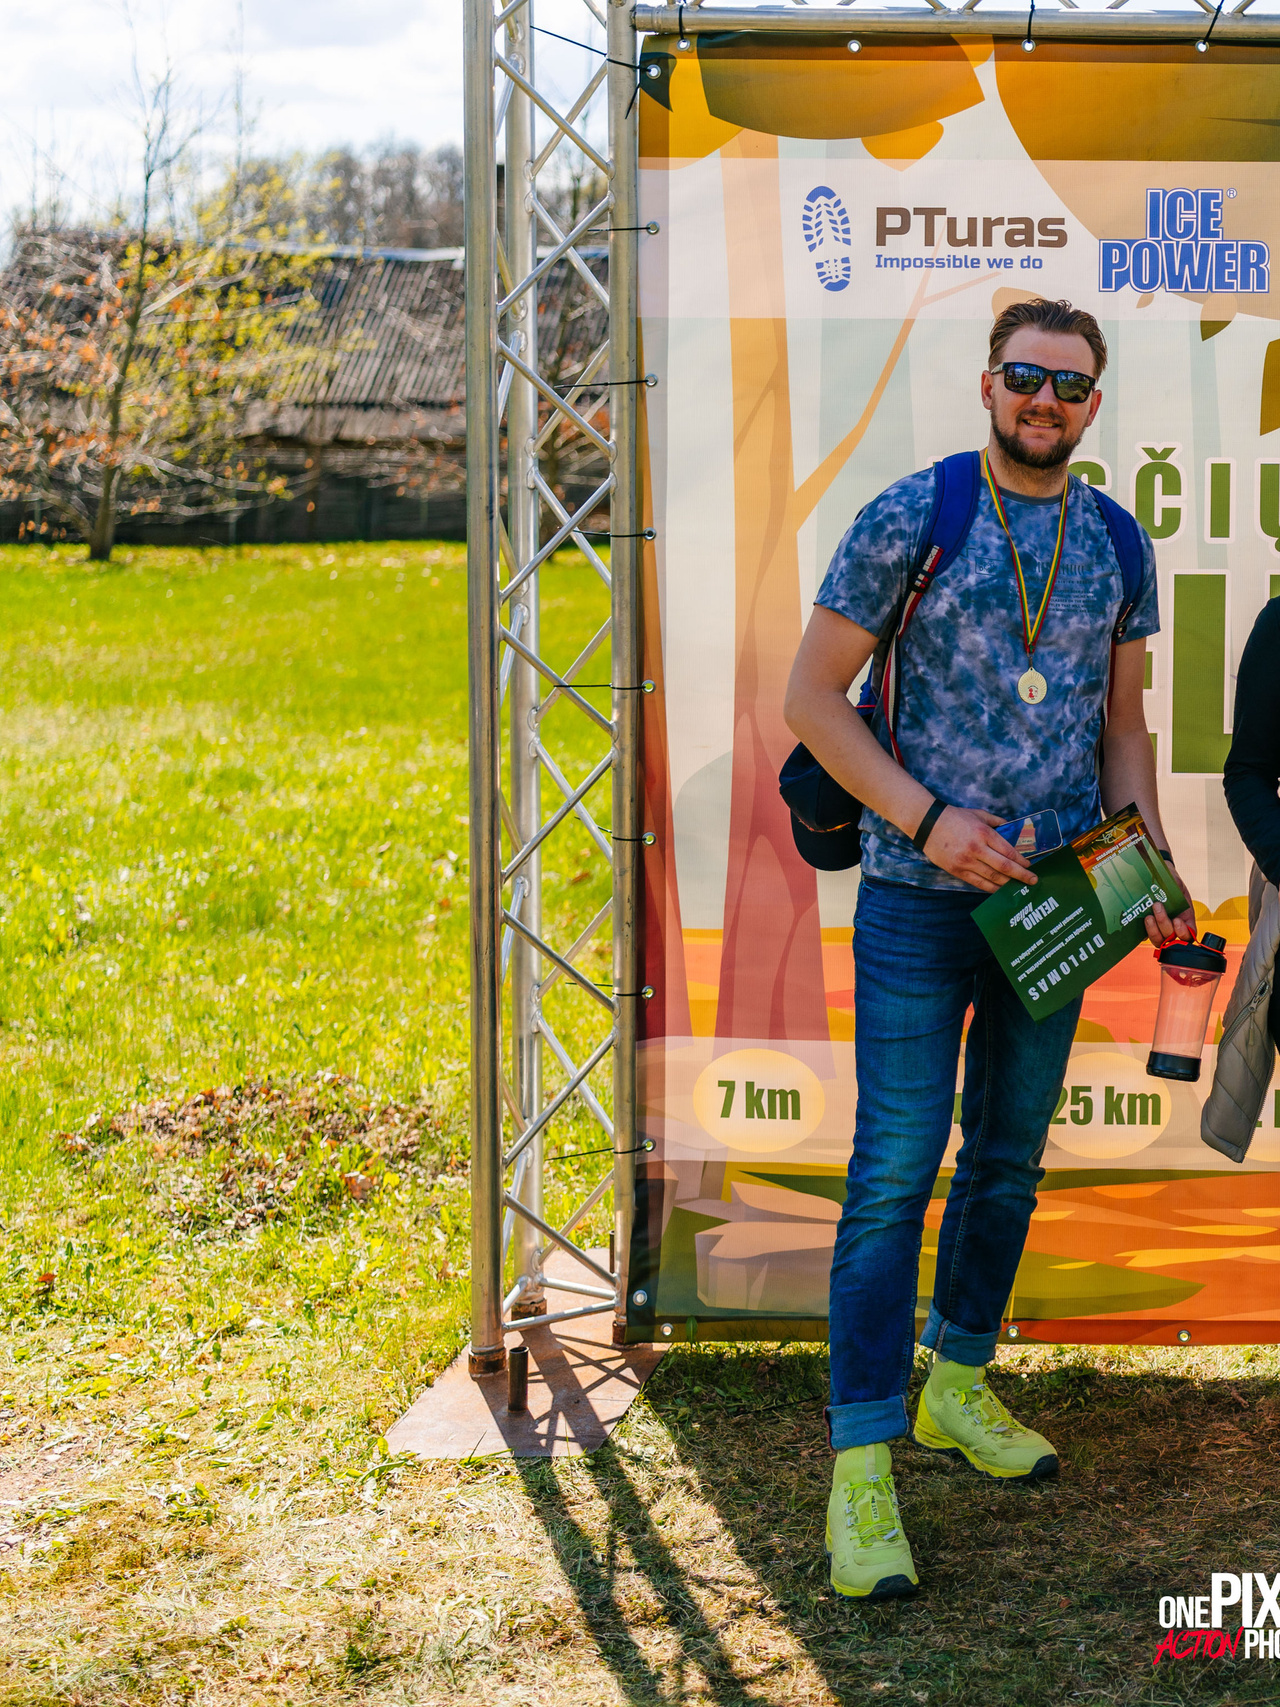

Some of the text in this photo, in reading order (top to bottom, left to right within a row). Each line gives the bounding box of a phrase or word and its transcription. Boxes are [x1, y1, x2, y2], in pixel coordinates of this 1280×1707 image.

[875, 207, 1068, 249] PTuras
[1146, 187, 1224, 241] ICE
[875, 254, 1043, 272] Impossible we do
[1099, 239, 1271, 293] POWER
[1009, 902, 1033, 927] keliais
[1021, 896, 1059, 930] VELNIO
[1121, 897, 1154, 926] PTuras
[1028, 933, 1105, 1001] DIPLOMAS
[717, 1081, 801, 1120] 7 km
[1050, 1085, 1161, 1125] 25 km
